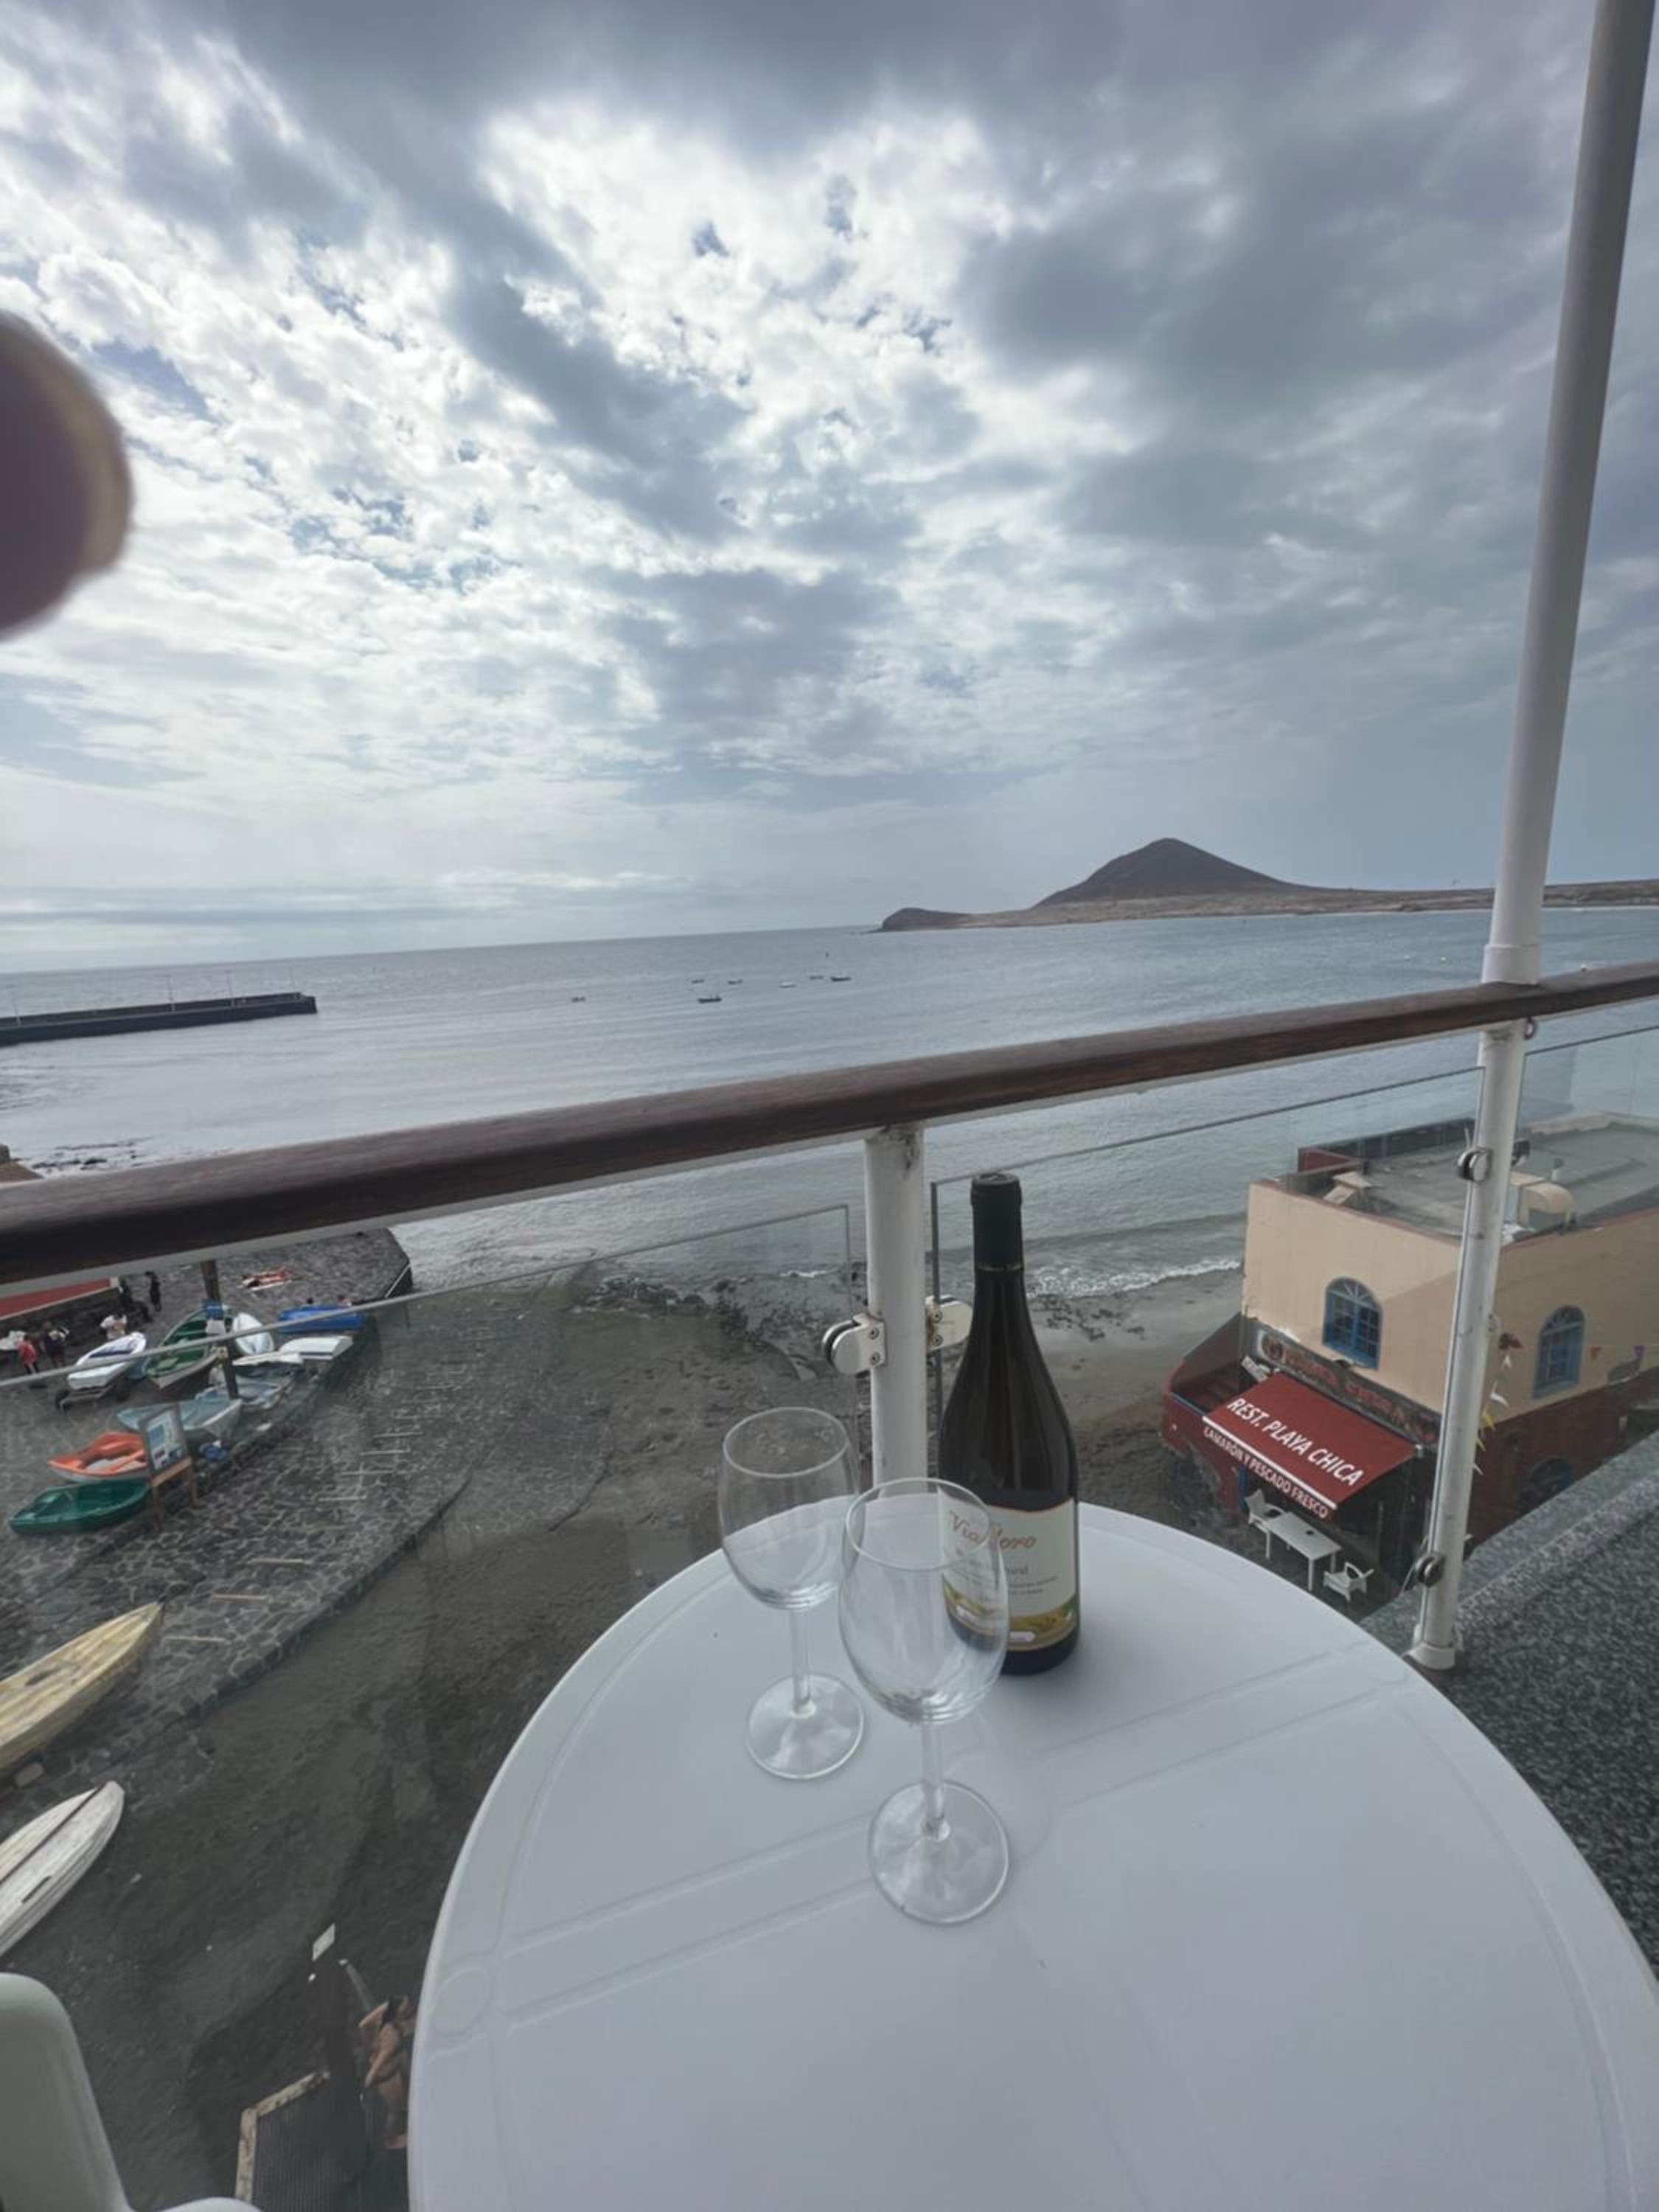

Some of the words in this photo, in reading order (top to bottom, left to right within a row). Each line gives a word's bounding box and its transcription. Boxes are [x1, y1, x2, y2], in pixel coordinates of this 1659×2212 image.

[1226, 1398, 1270, 1427] REST.
[1262, 1420, 1314, 1456] PLAYA
[1307, 1448, 1364, 1486] CHICA
[1243, 1454, 1251, 1465] Y
[1248, 1458, 1292, 1494] PESCADO
[1290, 1485, 1329, 1519] FRESCO
